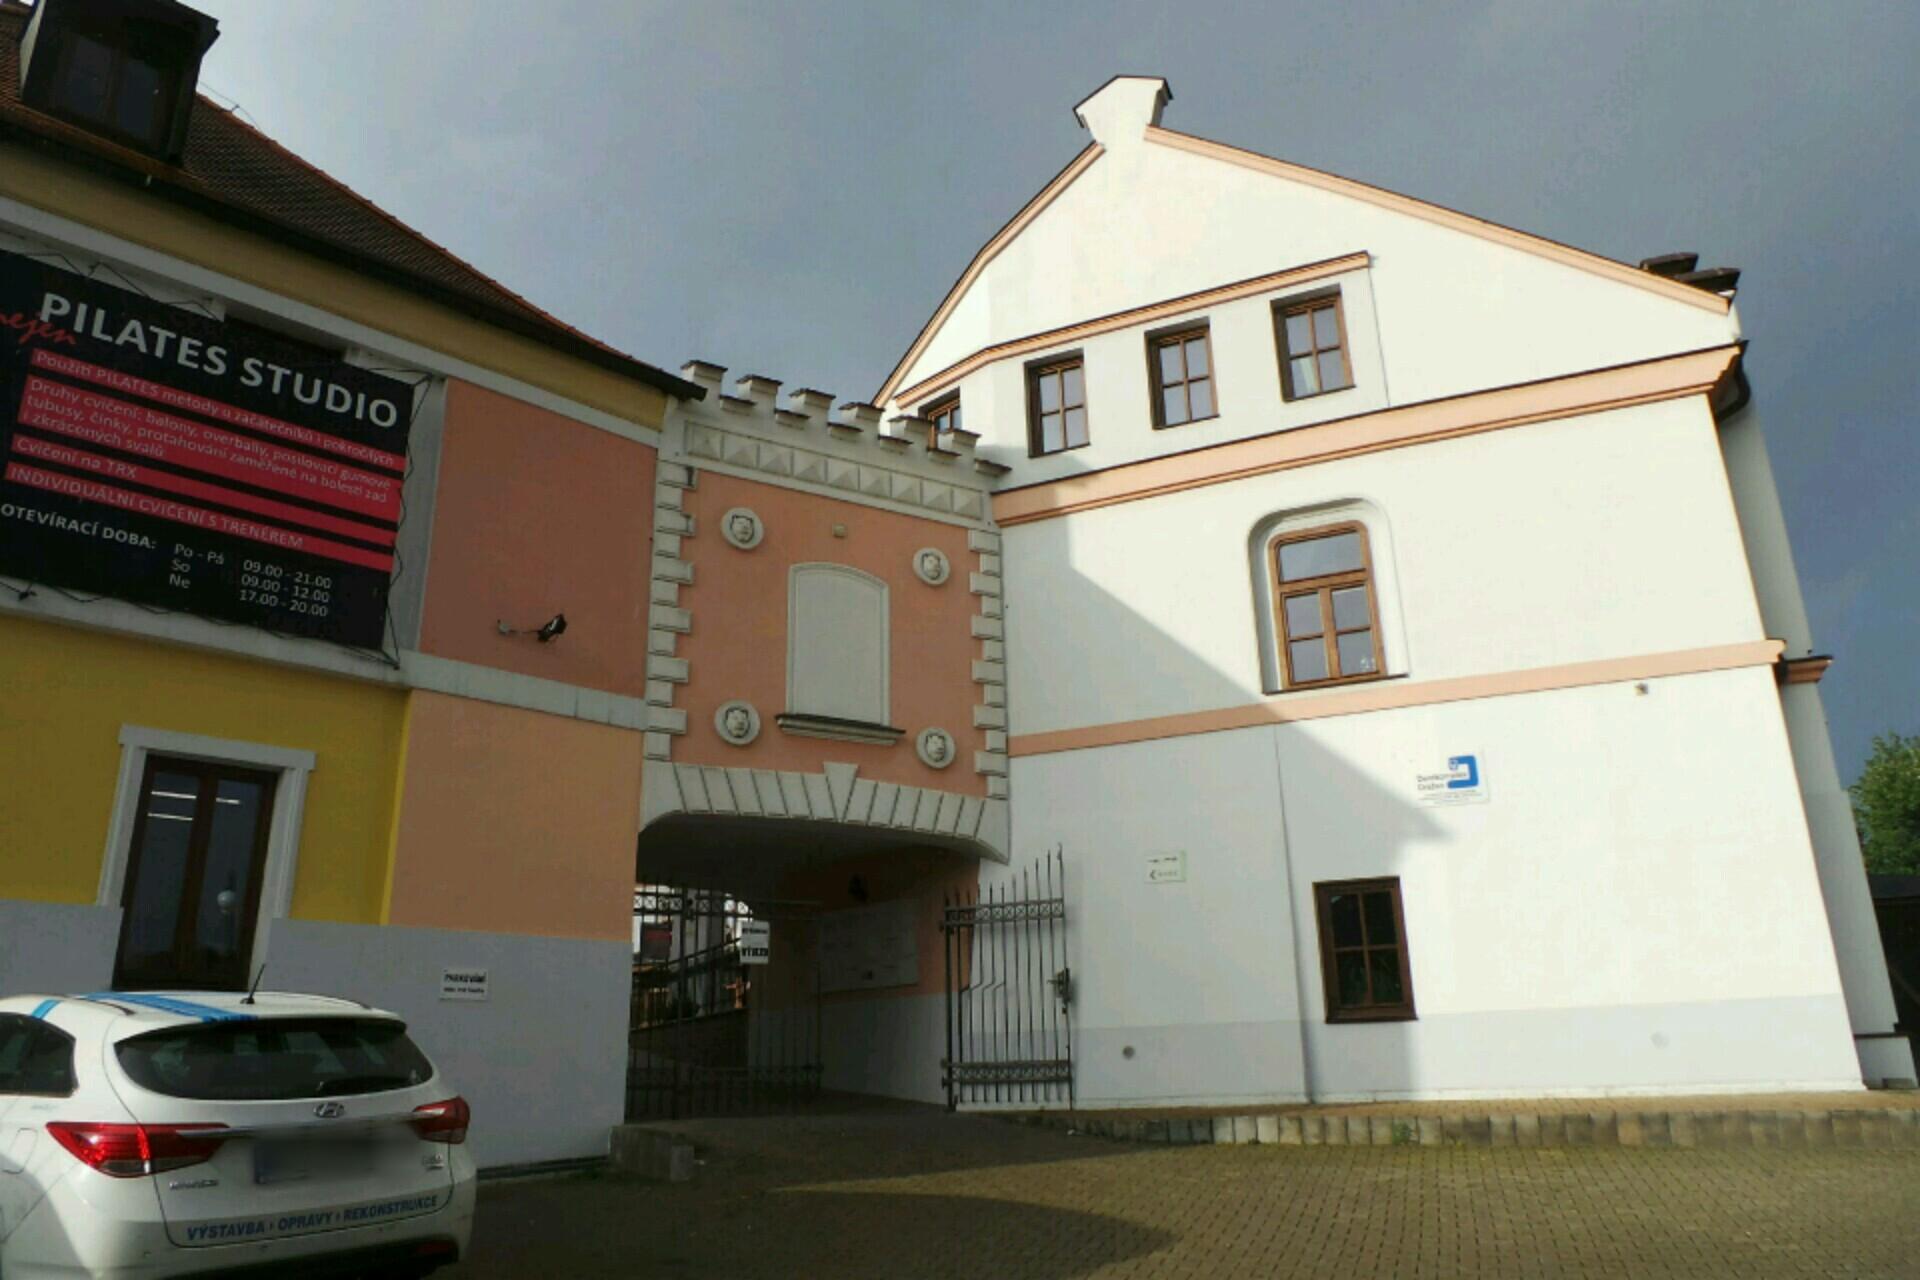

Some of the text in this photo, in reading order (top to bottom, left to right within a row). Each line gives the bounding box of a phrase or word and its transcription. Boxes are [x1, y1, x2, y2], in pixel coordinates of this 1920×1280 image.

[40, 292, 398, 428] PILATES STUDIO
[31, 379, 81, 402] Druhy
[203, 429, 269, 458] overbally,
[96, 370, 160, 396] PILATES
[162, 389, 219, 416] metody
[223, 408, 231, 418] u
[234, 411, 313, 441] začátečníků
[323, 438, 394, 466] pokročilých
[16, 438, 137, 479] Cvičení na TRX
[27, 395, 84, 421] tubusy,
[137, 425, 228, 457] protahování
[230, 452, 297, 480] zaměřené
[300, 472, 317, 485] na
[365, 488, 387, 504] zad
[1, 503, 158, 550] OTEVÍRACÍ DOBA:
[11, 467, 304, 547] INDIVIDUÁLNÍ CVIČENÍ S TRENÉREM
[171, 559, 191, 573] So
[241, 574, 281, 592] 09.00
[293, 585, 330, 603] 12.00
[174, 543, 193, 558] Po
[207, 551, 224, 565] Pá
[243, 559, 283, 578] 09.00
[295, 571, 332, 589] 21.00
[169, 574, 191, 588] Ne
[239, 589, 279, 607] 17.00
[289, 599, 328, 617] 20.00
[343, 1195, 438, 1222] REKONSTRUKCE
